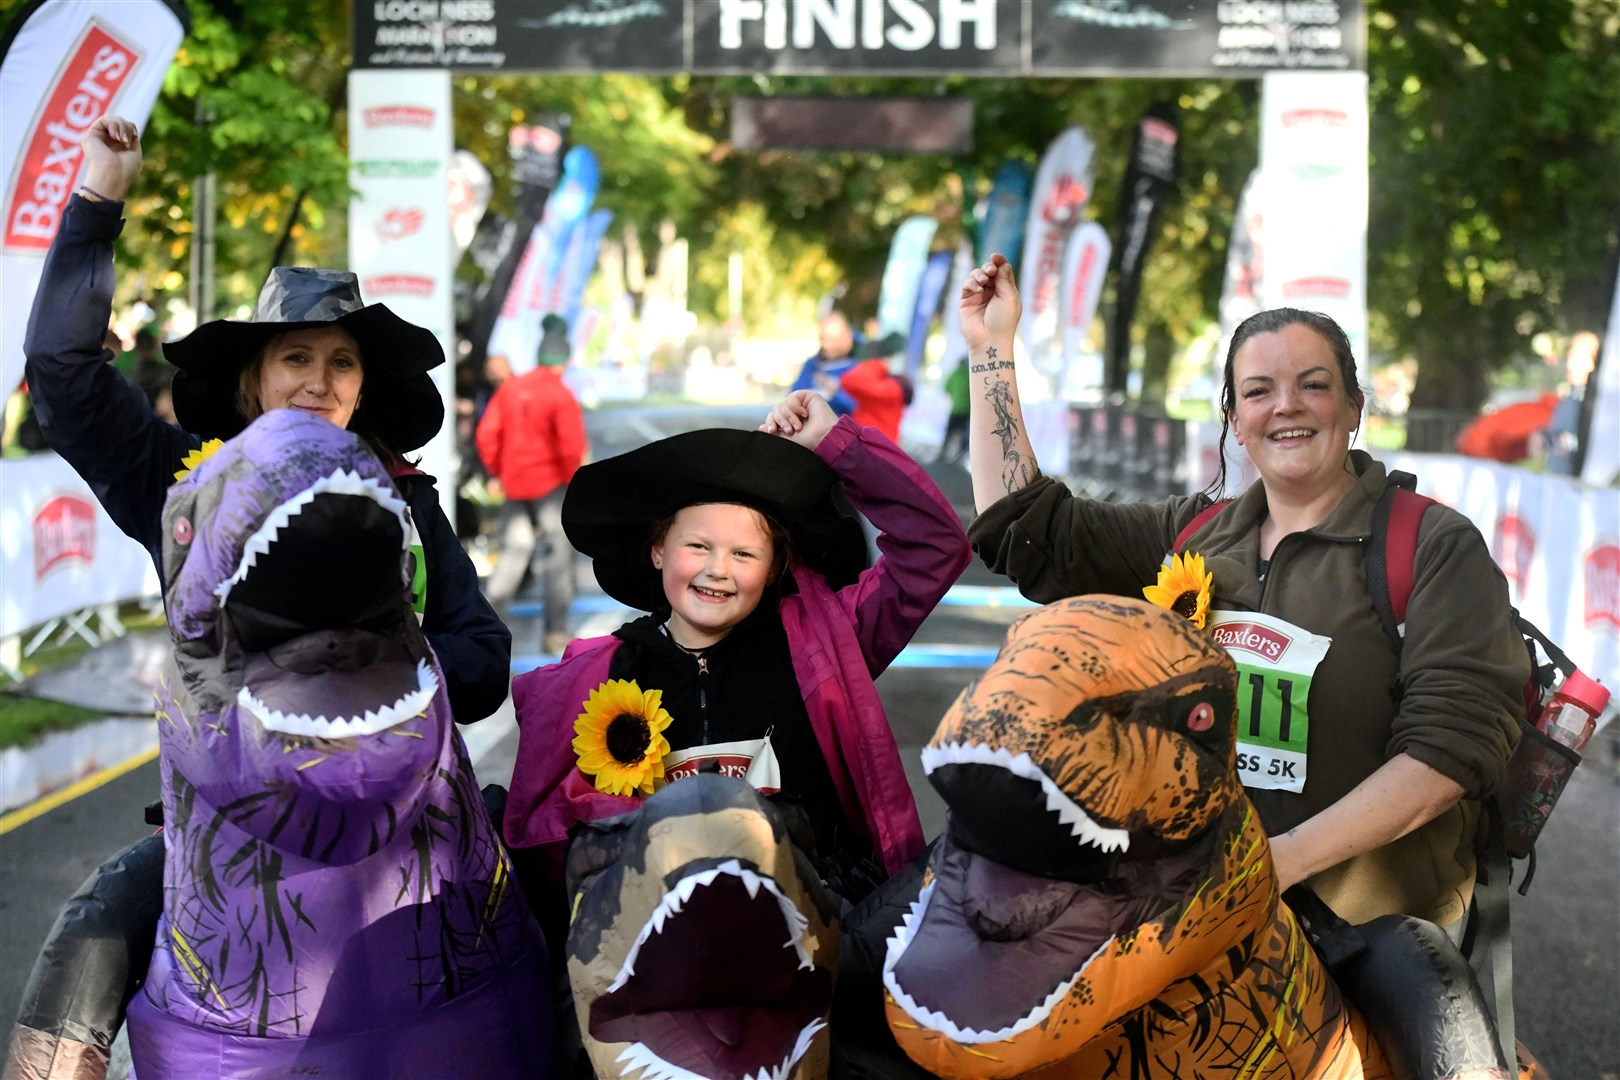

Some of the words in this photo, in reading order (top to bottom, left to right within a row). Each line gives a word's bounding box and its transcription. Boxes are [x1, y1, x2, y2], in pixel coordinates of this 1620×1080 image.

[719, 0, 998, 50] FINISH
[12, 44, 128, 239] Baxters
[1213, 628, 1281, 657] Baxters
[1237, 671, 1294, 742] 11
[1267, 758, 1296, 778] 5K
